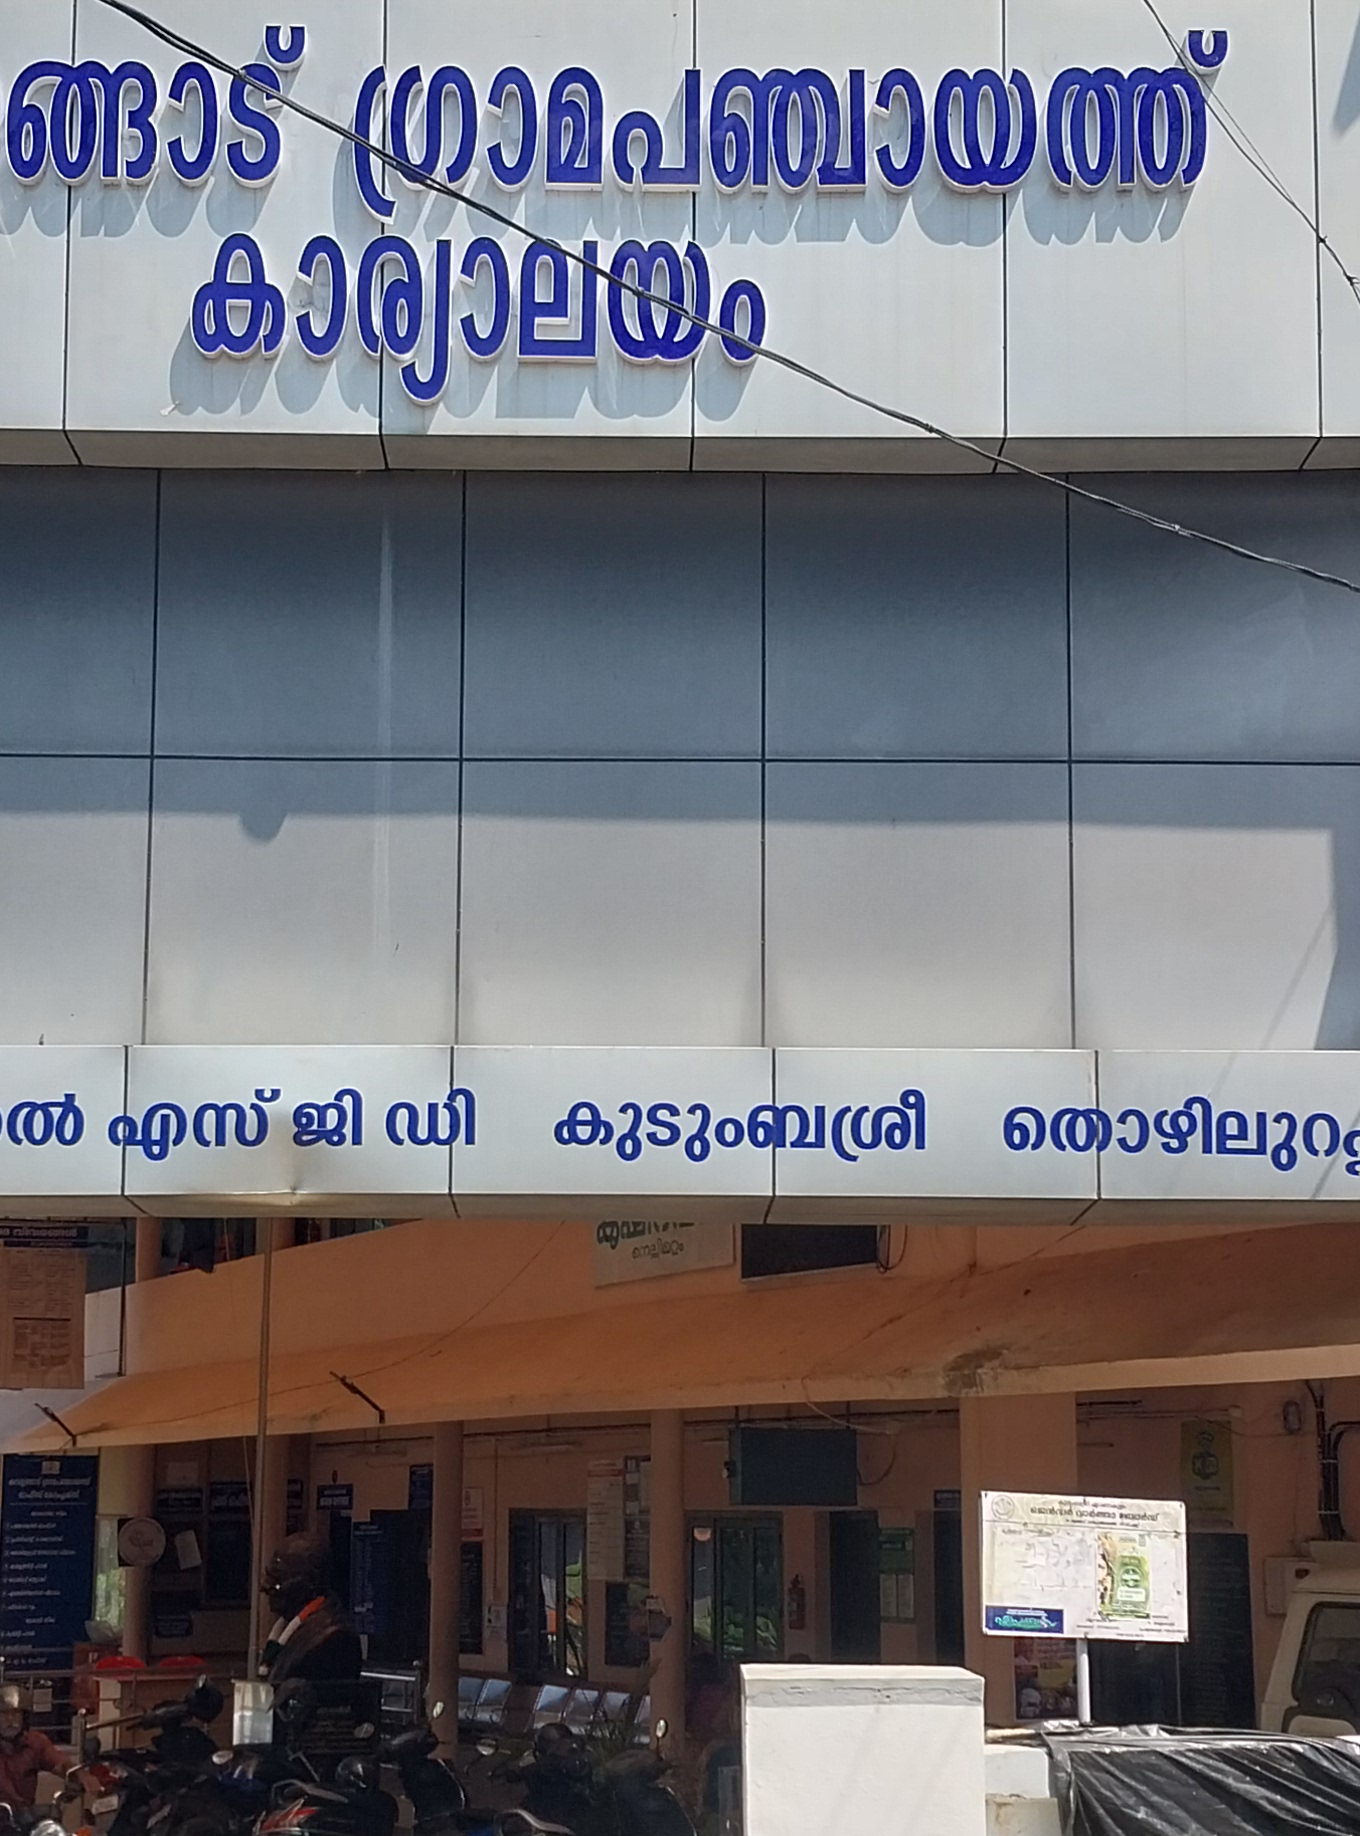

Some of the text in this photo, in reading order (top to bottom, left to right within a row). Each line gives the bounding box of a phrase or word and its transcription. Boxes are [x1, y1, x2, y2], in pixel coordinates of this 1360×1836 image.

[353, 29, 1228, 221] ഗ്രാമപഞ്ചായത്ത്
[191, 232, 767, 402] കാര്യാലയം
[107, 1088, 283, 1161] എസ്
[293, 1088, 363, 1147] ജി
[385, 1087, 477, 1146] ഡി
[553, 1088, 927, 1163] കുടുംബശ്രീ
